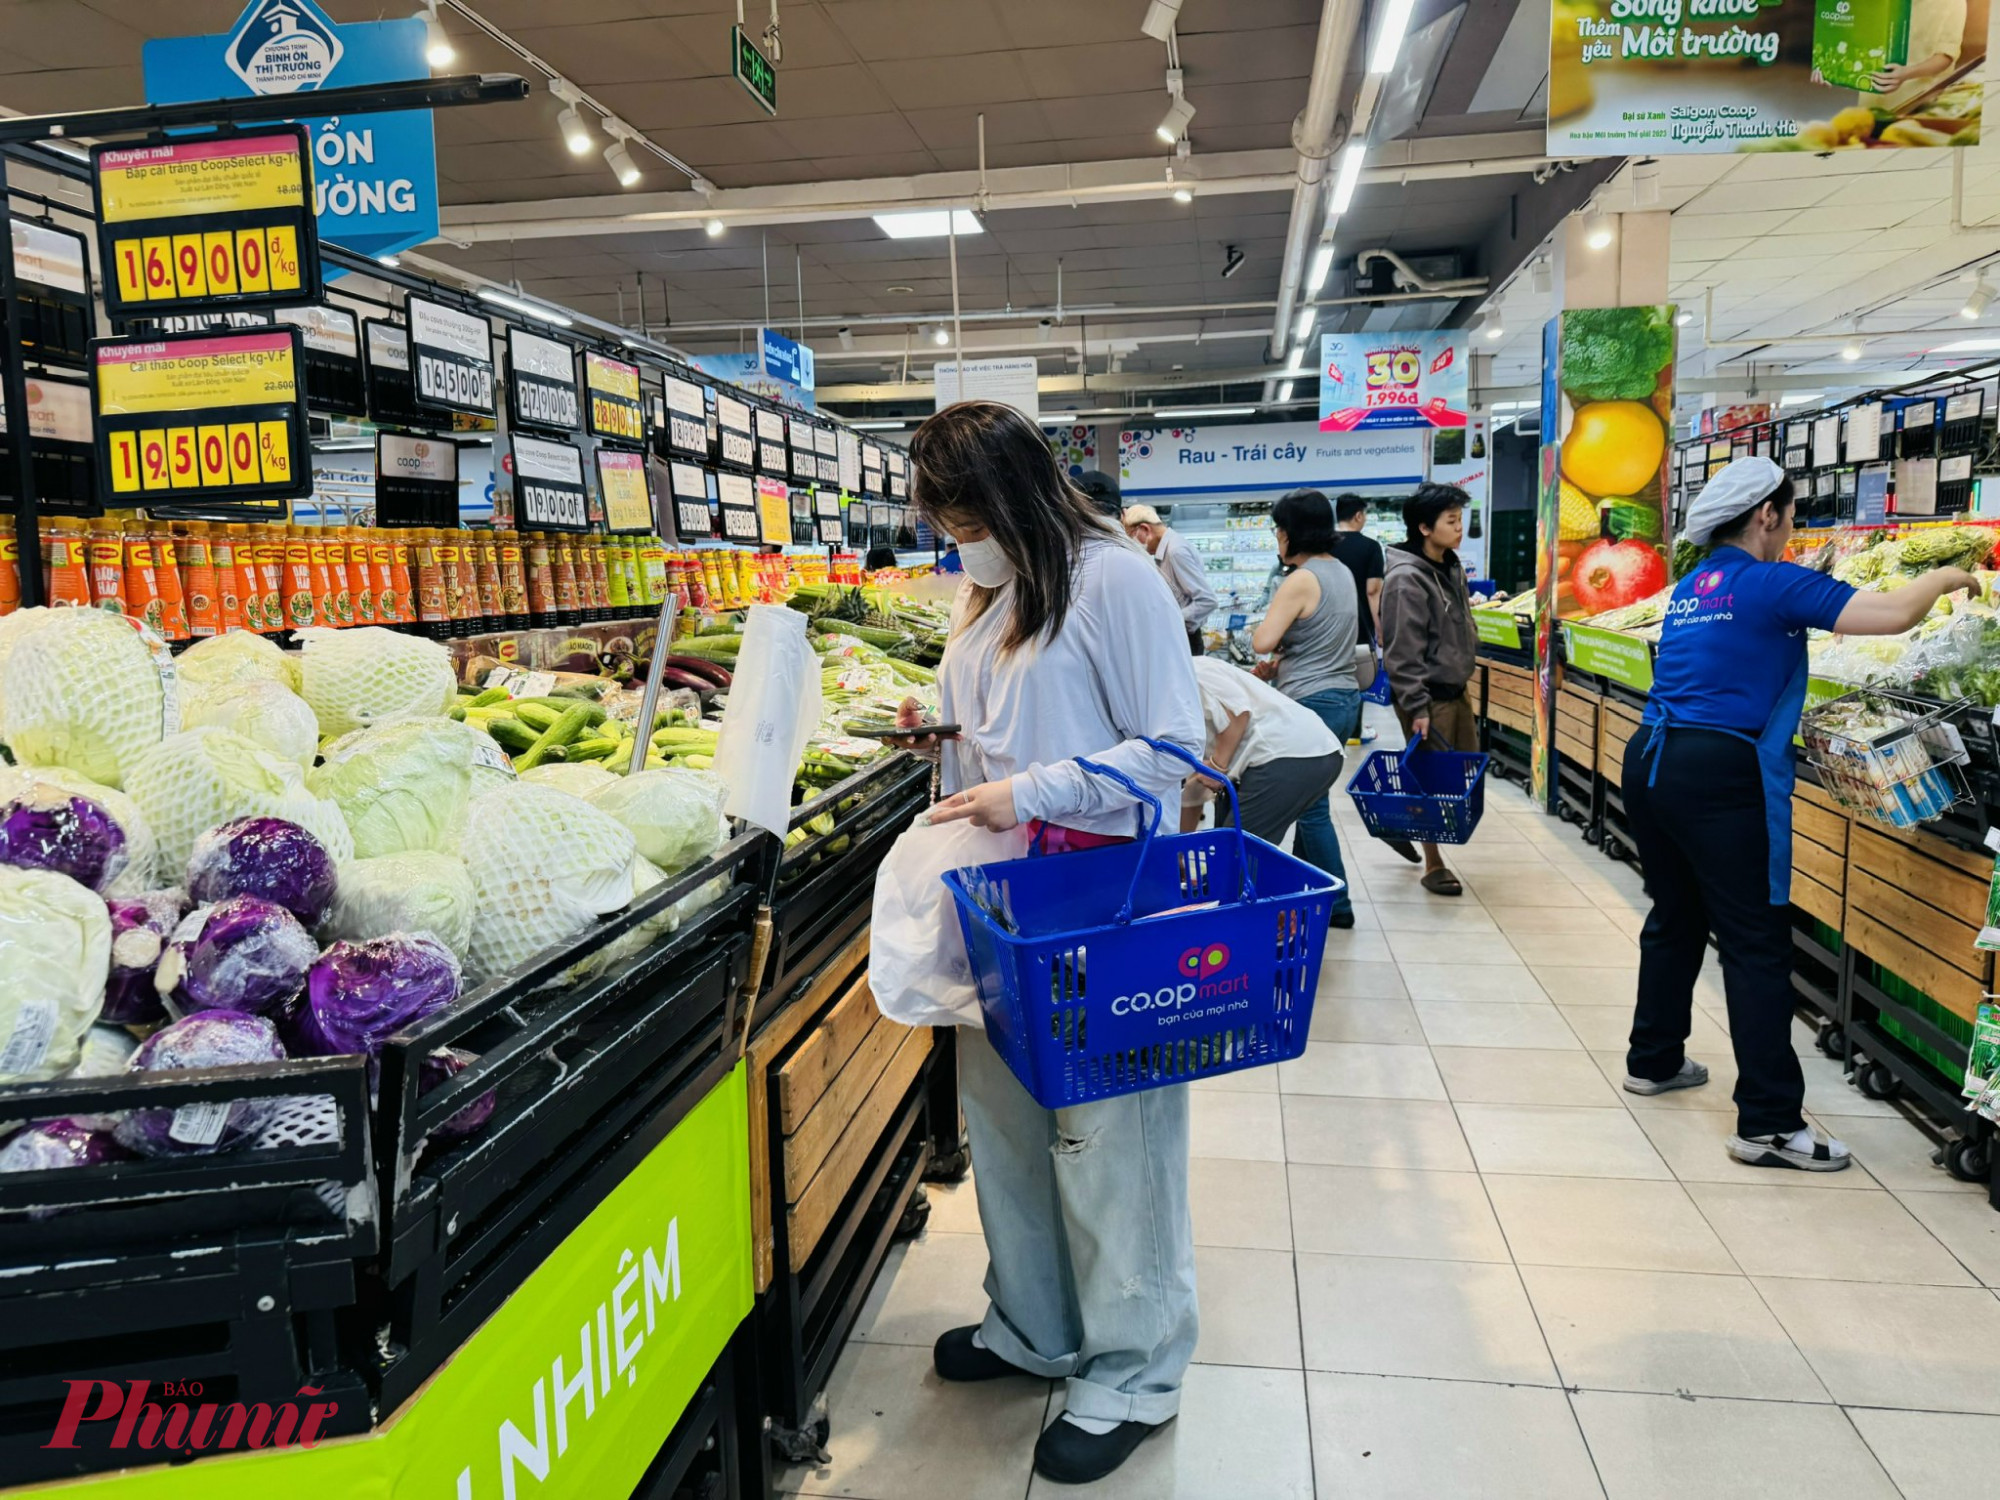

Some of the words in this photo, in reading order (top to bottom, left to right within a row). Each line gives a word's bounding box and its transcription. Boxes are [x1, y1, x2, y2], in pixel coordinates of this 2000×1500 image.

[1577, 17, 1620, 36] Thêm
[1582, 39, 1613, 63] yêu
[1621, 26, 1677, 57] Môi
[1681, 25, 1780, 62] trường
[255, 65, 274, 76] THỊ
[276, 60, 322, 73] TRƯỜNG
[265, 51, 292, 64] BÌNH
[293, 50, 308, 61] ỔN
[1647, 112, 1666, 120] Xanh
[1671, 105, 1717, 120] Saigon
[1718, 104, 1758, 120] Co.op
[1727, 120, 1774, 138] Thanh
[1777, 119, 1800, 138] Hà
[316, 116, 374, 166] ỔN
[104, 148, 150, 166] Khuyến
[200, 154, 266, 172] CoopSelect
[124, 238, 261, 289] 16.900
[271, 236, 296, 276] đ/kg
[178, 354, 208, 370] Coop
[212, 352, 246, 367] Select
[1365, 351, 1420, 386] 30
[424, 364, 480, 398] 16.500
[520, 388, 567, 416] 27.900
[119, 432, 251, 480] 19.500
[262, 432, 286, 470] đ/kg
[1178, 448, 1215, 464] Rau
[1232, 444, 1268, 462] Trái
[1273, 442, 1307, 462] cây
[1316, 448, 1342, 458] Fruits
[1344, 446, 1362, 457] and
[1364, 444, 1415, 457] vegetables
[528, 491, 575, 519] 19.000
[1714, 612, 1733, 620] nhà
[1158, 1016, 1180, 1026] bạn
[1183, 1008, 1204, 1020] của
[1206, 1004, 1226, 1015] mọi
[1228, 999, 1249, 1012] nhà
[498, 1215, 682, 1500] NHIỆM
